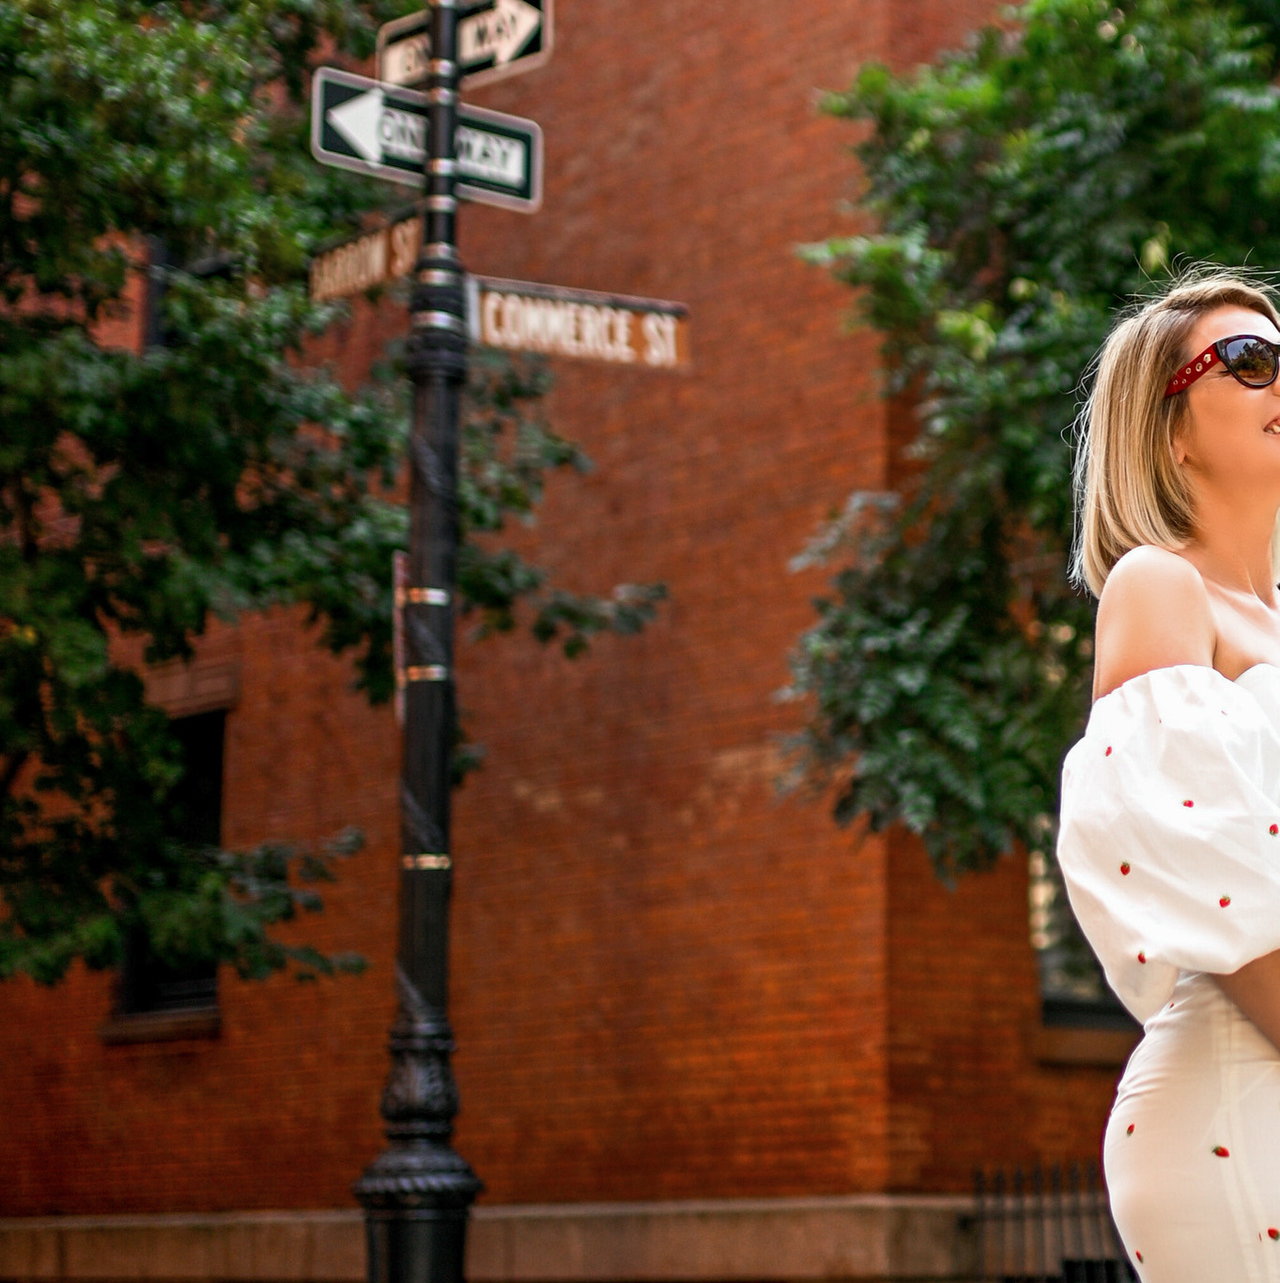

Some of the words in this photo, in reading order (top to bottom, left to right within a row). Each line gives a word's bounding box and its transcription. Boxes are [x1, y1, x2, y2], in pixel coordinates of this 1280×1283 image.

[402, 36, 431, 75] ON
[378, 107, 427, 153] ON
[484, 291, 636, 363] COMMERCE
[642, 312, 678, 366] ST
